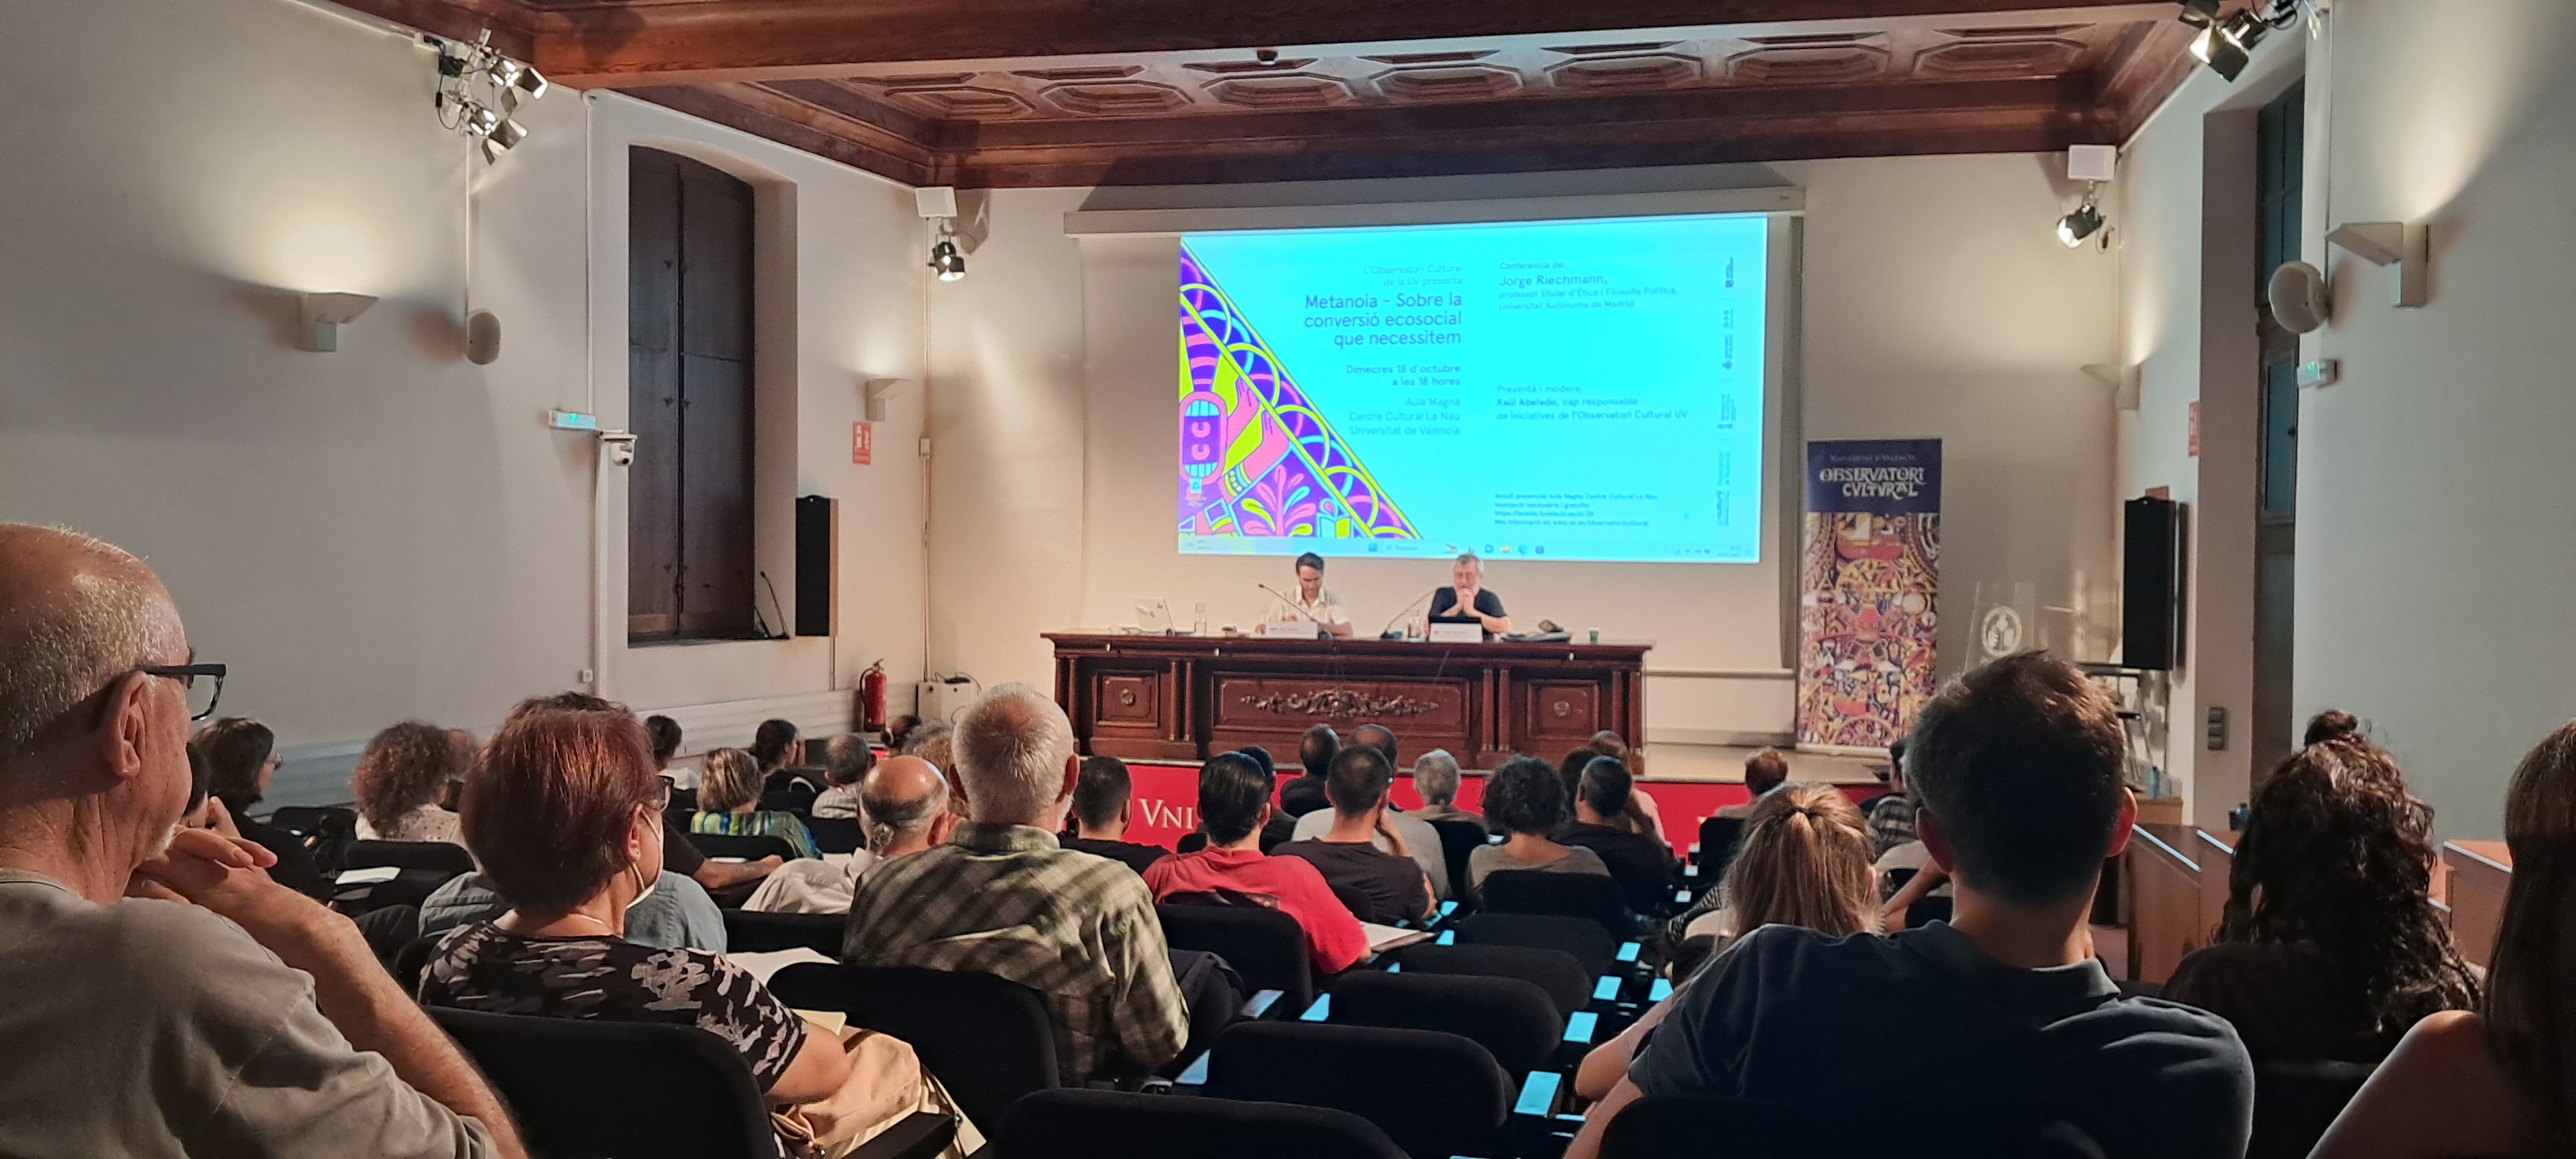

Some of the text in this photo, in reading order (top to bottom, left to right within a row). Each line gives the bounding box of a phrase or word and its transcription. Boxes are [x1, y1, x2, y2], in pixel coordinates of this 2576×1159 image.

[1427, 264, 1464, 273] Cultural
[1383, 277, 1395, 286] de
[1407, 276, 1420, 285] UV
[1422, 275, 1463, 287] presenta
[1499, 274, 1608, 288] Jorge Riechmann,
[1305, 293, 1378, 309] Metanoia
[1395, 292, 1444, 307] Sobre
[1448, 291, 1463, 307] la
[1304, 310, 1462, 327] conversió ecosocial
[1333, 330, 1462, 349] que necessitem
[1346, 364, 1393, 374] Dimecres
[1401, 377, 1415, 386] les
[1431, 375, 1462, 386] hores
[1405, 396, 1461, 408] Aula Magna
[1349, 412, 1460, 421] Centre Cultural La Nau
[1674, 409, 1689, 419] UV
[1350, 425, 1401, 435] Universitat
[1405, 426, 1417, 434] de
